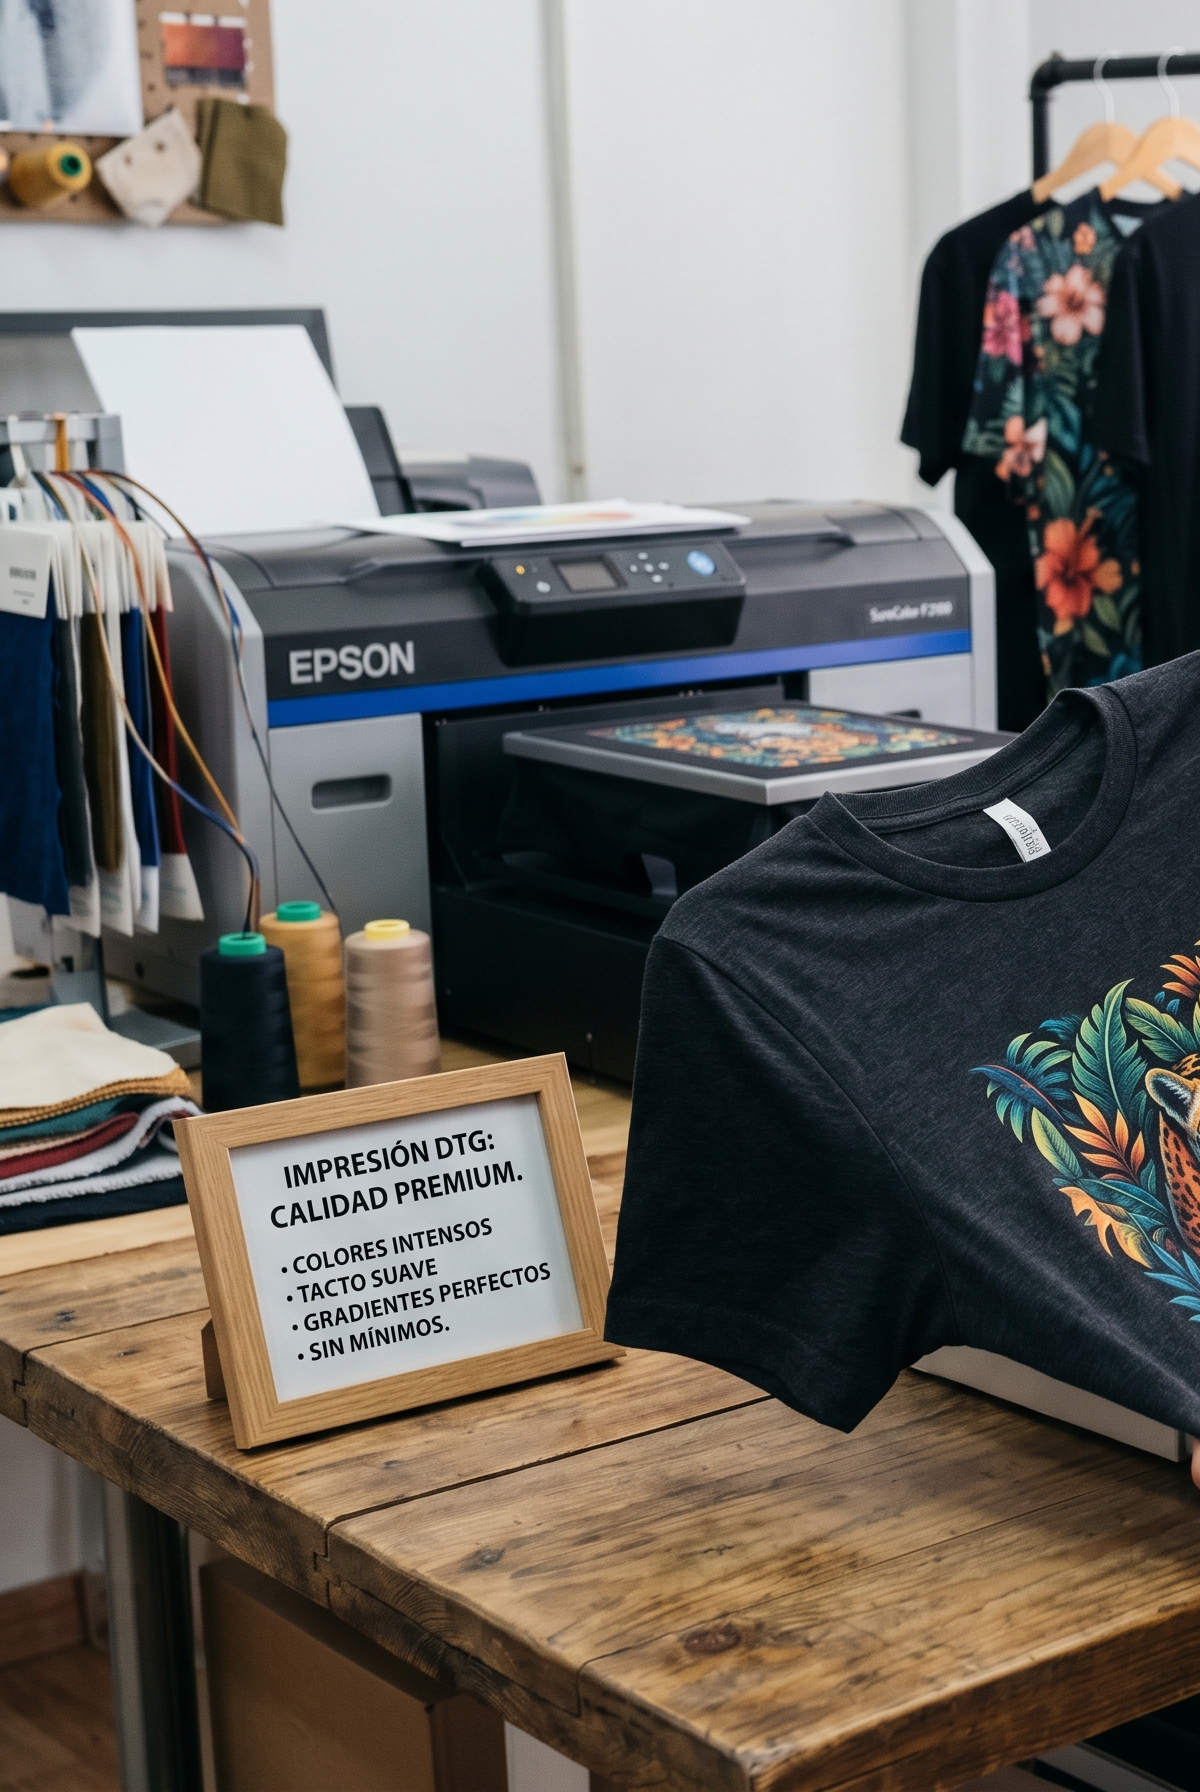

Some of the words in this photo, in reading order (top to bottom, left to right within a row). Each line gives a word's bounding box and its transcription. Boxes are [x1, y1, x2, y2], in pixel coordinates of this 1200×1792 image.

[289, 640, 415, 685] EPSON
[283, 1139, 430, 1189] IMPRESIÓN
[435, 1130, 495, 1160] DTG:
[270, 1186, 388, 1228] CALIDAD
[394, 1160, 523, 1205] PREMIUM.
[292, 1239, 388, 1274] COLORES
[392, 1217, 493, 1255] INTENSOS
[296, 1273, 367, 1303] TACTO
[371, 1258, 438, 1288] SUAVE
[303, 1287, 435, 1332] GRADIENTES
[439, 1262, 551, 1303] PERFECTOS
[309, 1337, 345, 1361] SIN
[349, 1315, 450, 1353] MÍNIMOS.
